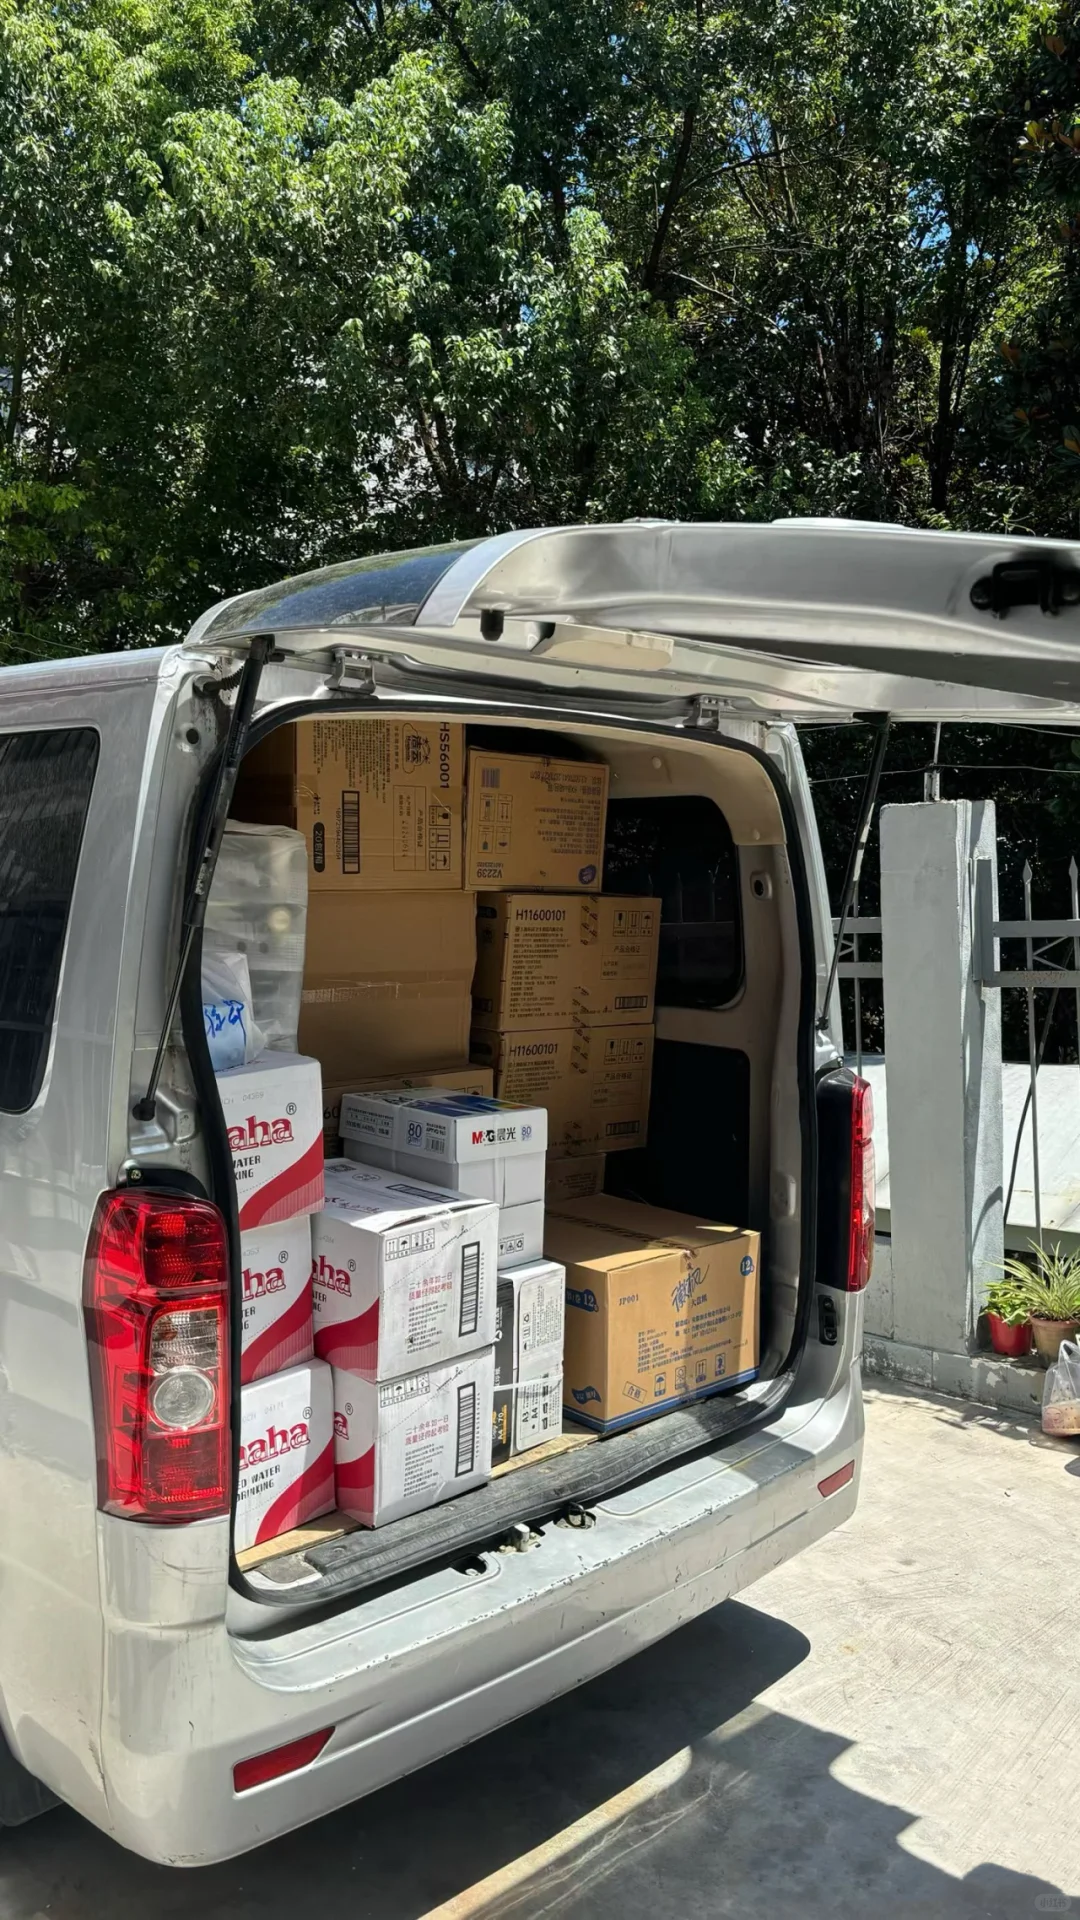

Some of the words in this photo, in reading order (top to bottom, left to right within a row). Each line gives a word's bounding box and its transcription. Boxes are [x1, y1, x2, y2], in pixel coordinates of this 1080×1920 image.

[440, 722, 450, 789] HS56001
[477, 869, 502, 878] V2239
[516, 909, 566, 921] H11600101
[509, 1044, 558, 1056] H11600101
[408, 1123, 422, 1138] 80
[472, 1130, 495, 1144] M&G
[497, 1127, 516, 1141] 晨光
[522, 1126, 532, 1136] 80
[742, 1260, 750, 1272] 12
[409, 1272, 452, 1290] 二十余年如一日
[583, 1294, 594, 1306] 12
[618, 1293, 638, 1306] JP001
[522, 1412, 529, 1422] A3
[532, 1408, 538, 1418] A4
[406, 1414, 448, 1435] 二十余年如一日
[405, 1424, 448, 1445] 质量经得起考验
[252, 1464, 280, 1482] WATER
